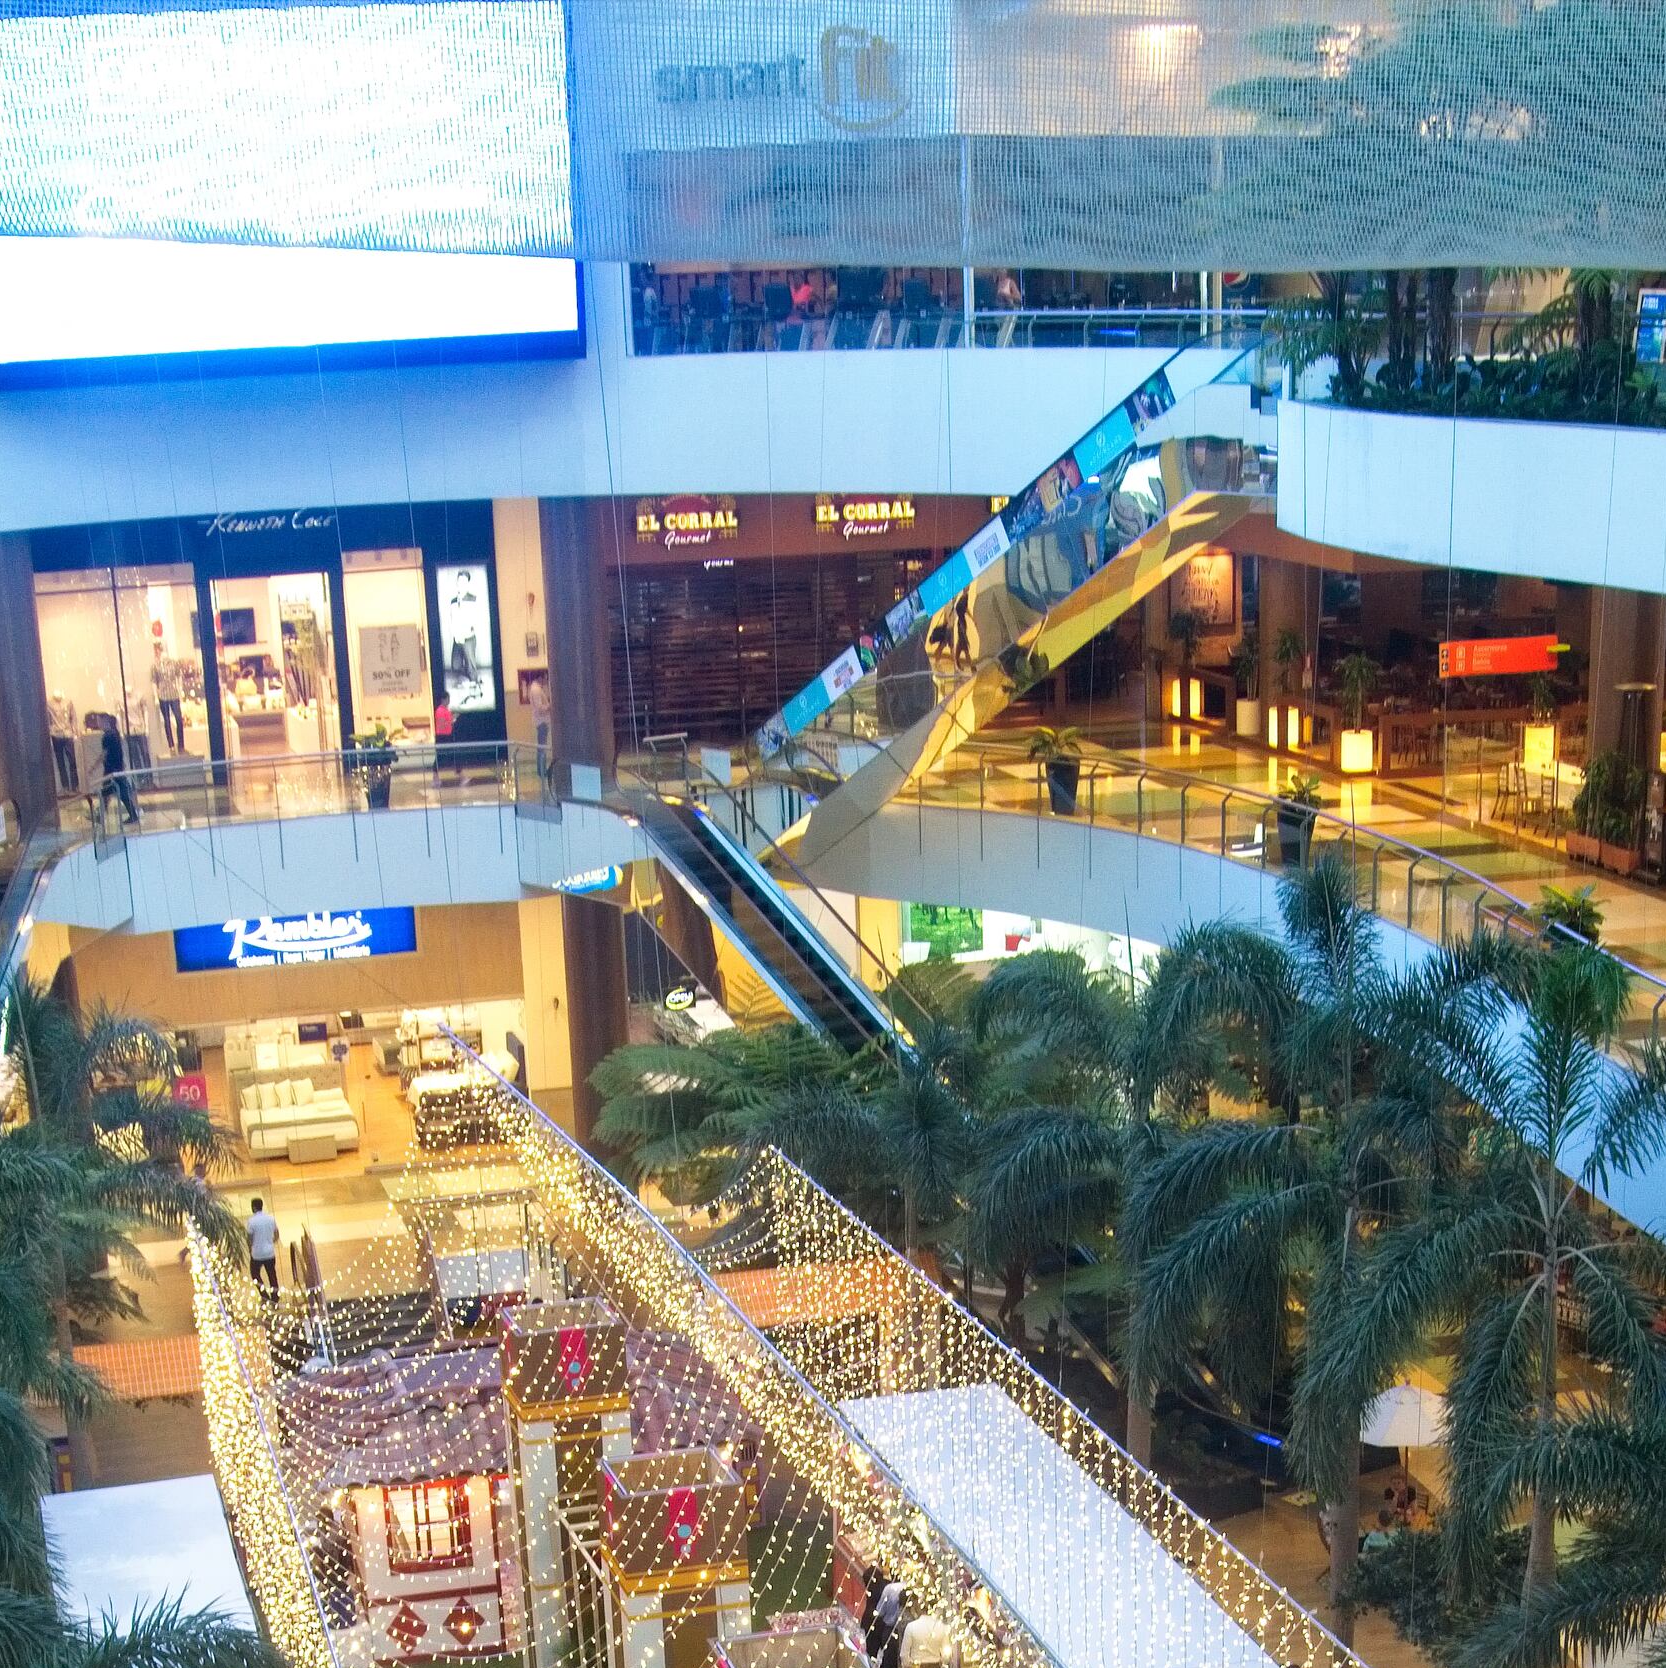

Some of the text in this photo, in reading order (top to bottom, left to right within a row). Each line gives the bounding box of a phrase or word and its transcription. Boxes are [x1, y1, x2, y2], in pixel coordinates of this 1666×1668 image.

[637, 511, 738, 532] EL CORRAL
[816, 502, 916, 523] EL CORRAL
[664, 530, 712, 550] Gourmet
[843, 521, 889, 541] Gourmet
